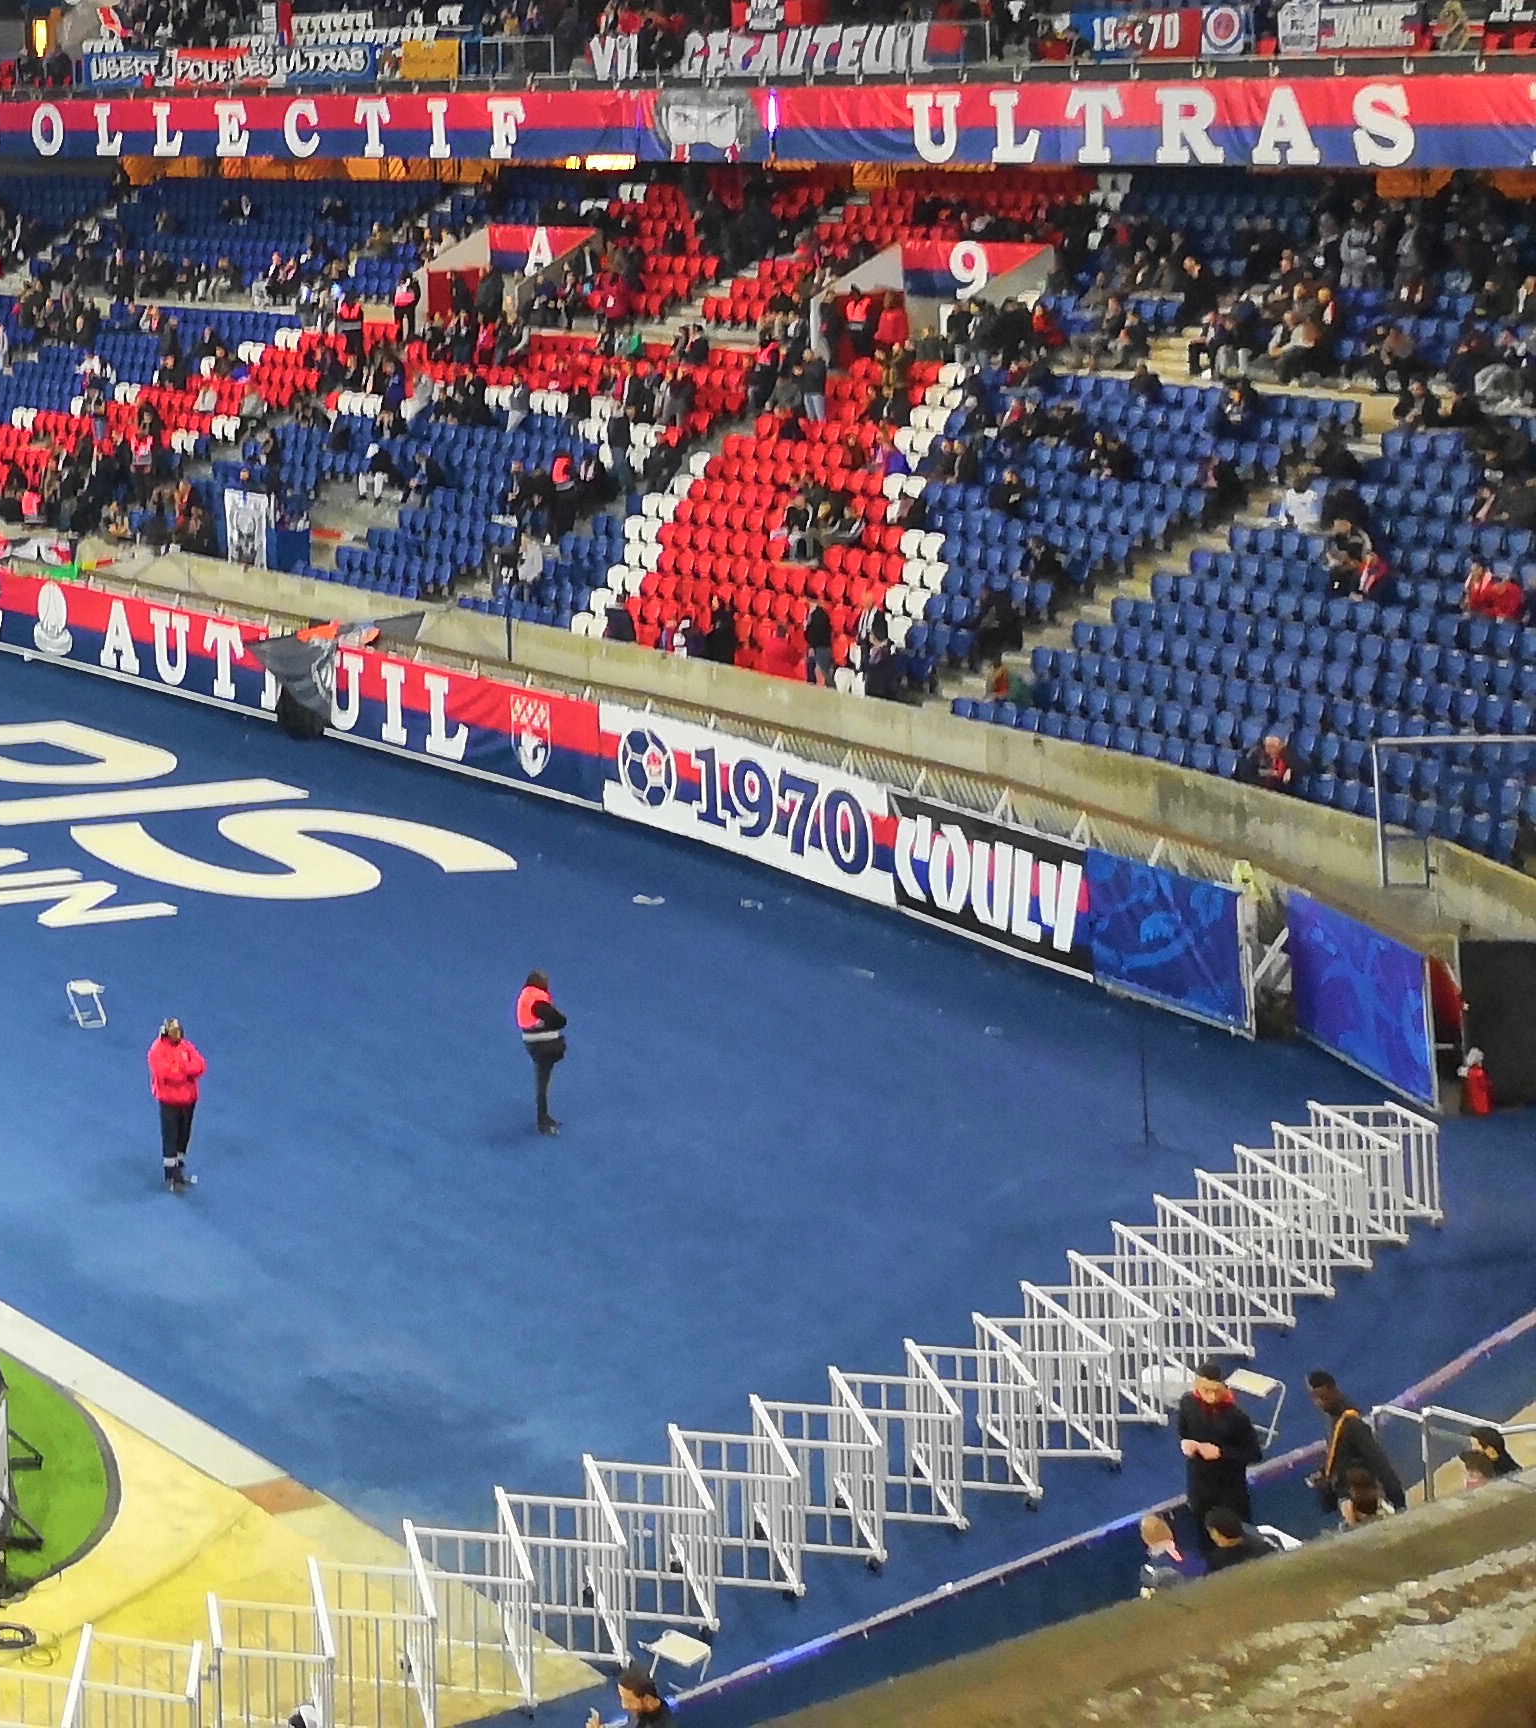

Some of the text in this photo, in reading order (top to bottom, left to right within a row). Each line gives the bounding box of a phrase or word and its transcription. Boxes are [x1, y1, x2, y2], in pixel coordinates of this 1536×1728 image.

[906, 82, 1416, 167] ULTRAS
[523, 225, 553, 279] A
[949, 240, 989, 300] 9
[99, 599, 470, 762] AUTUIL
[691, 747, 873, 876] 1970
